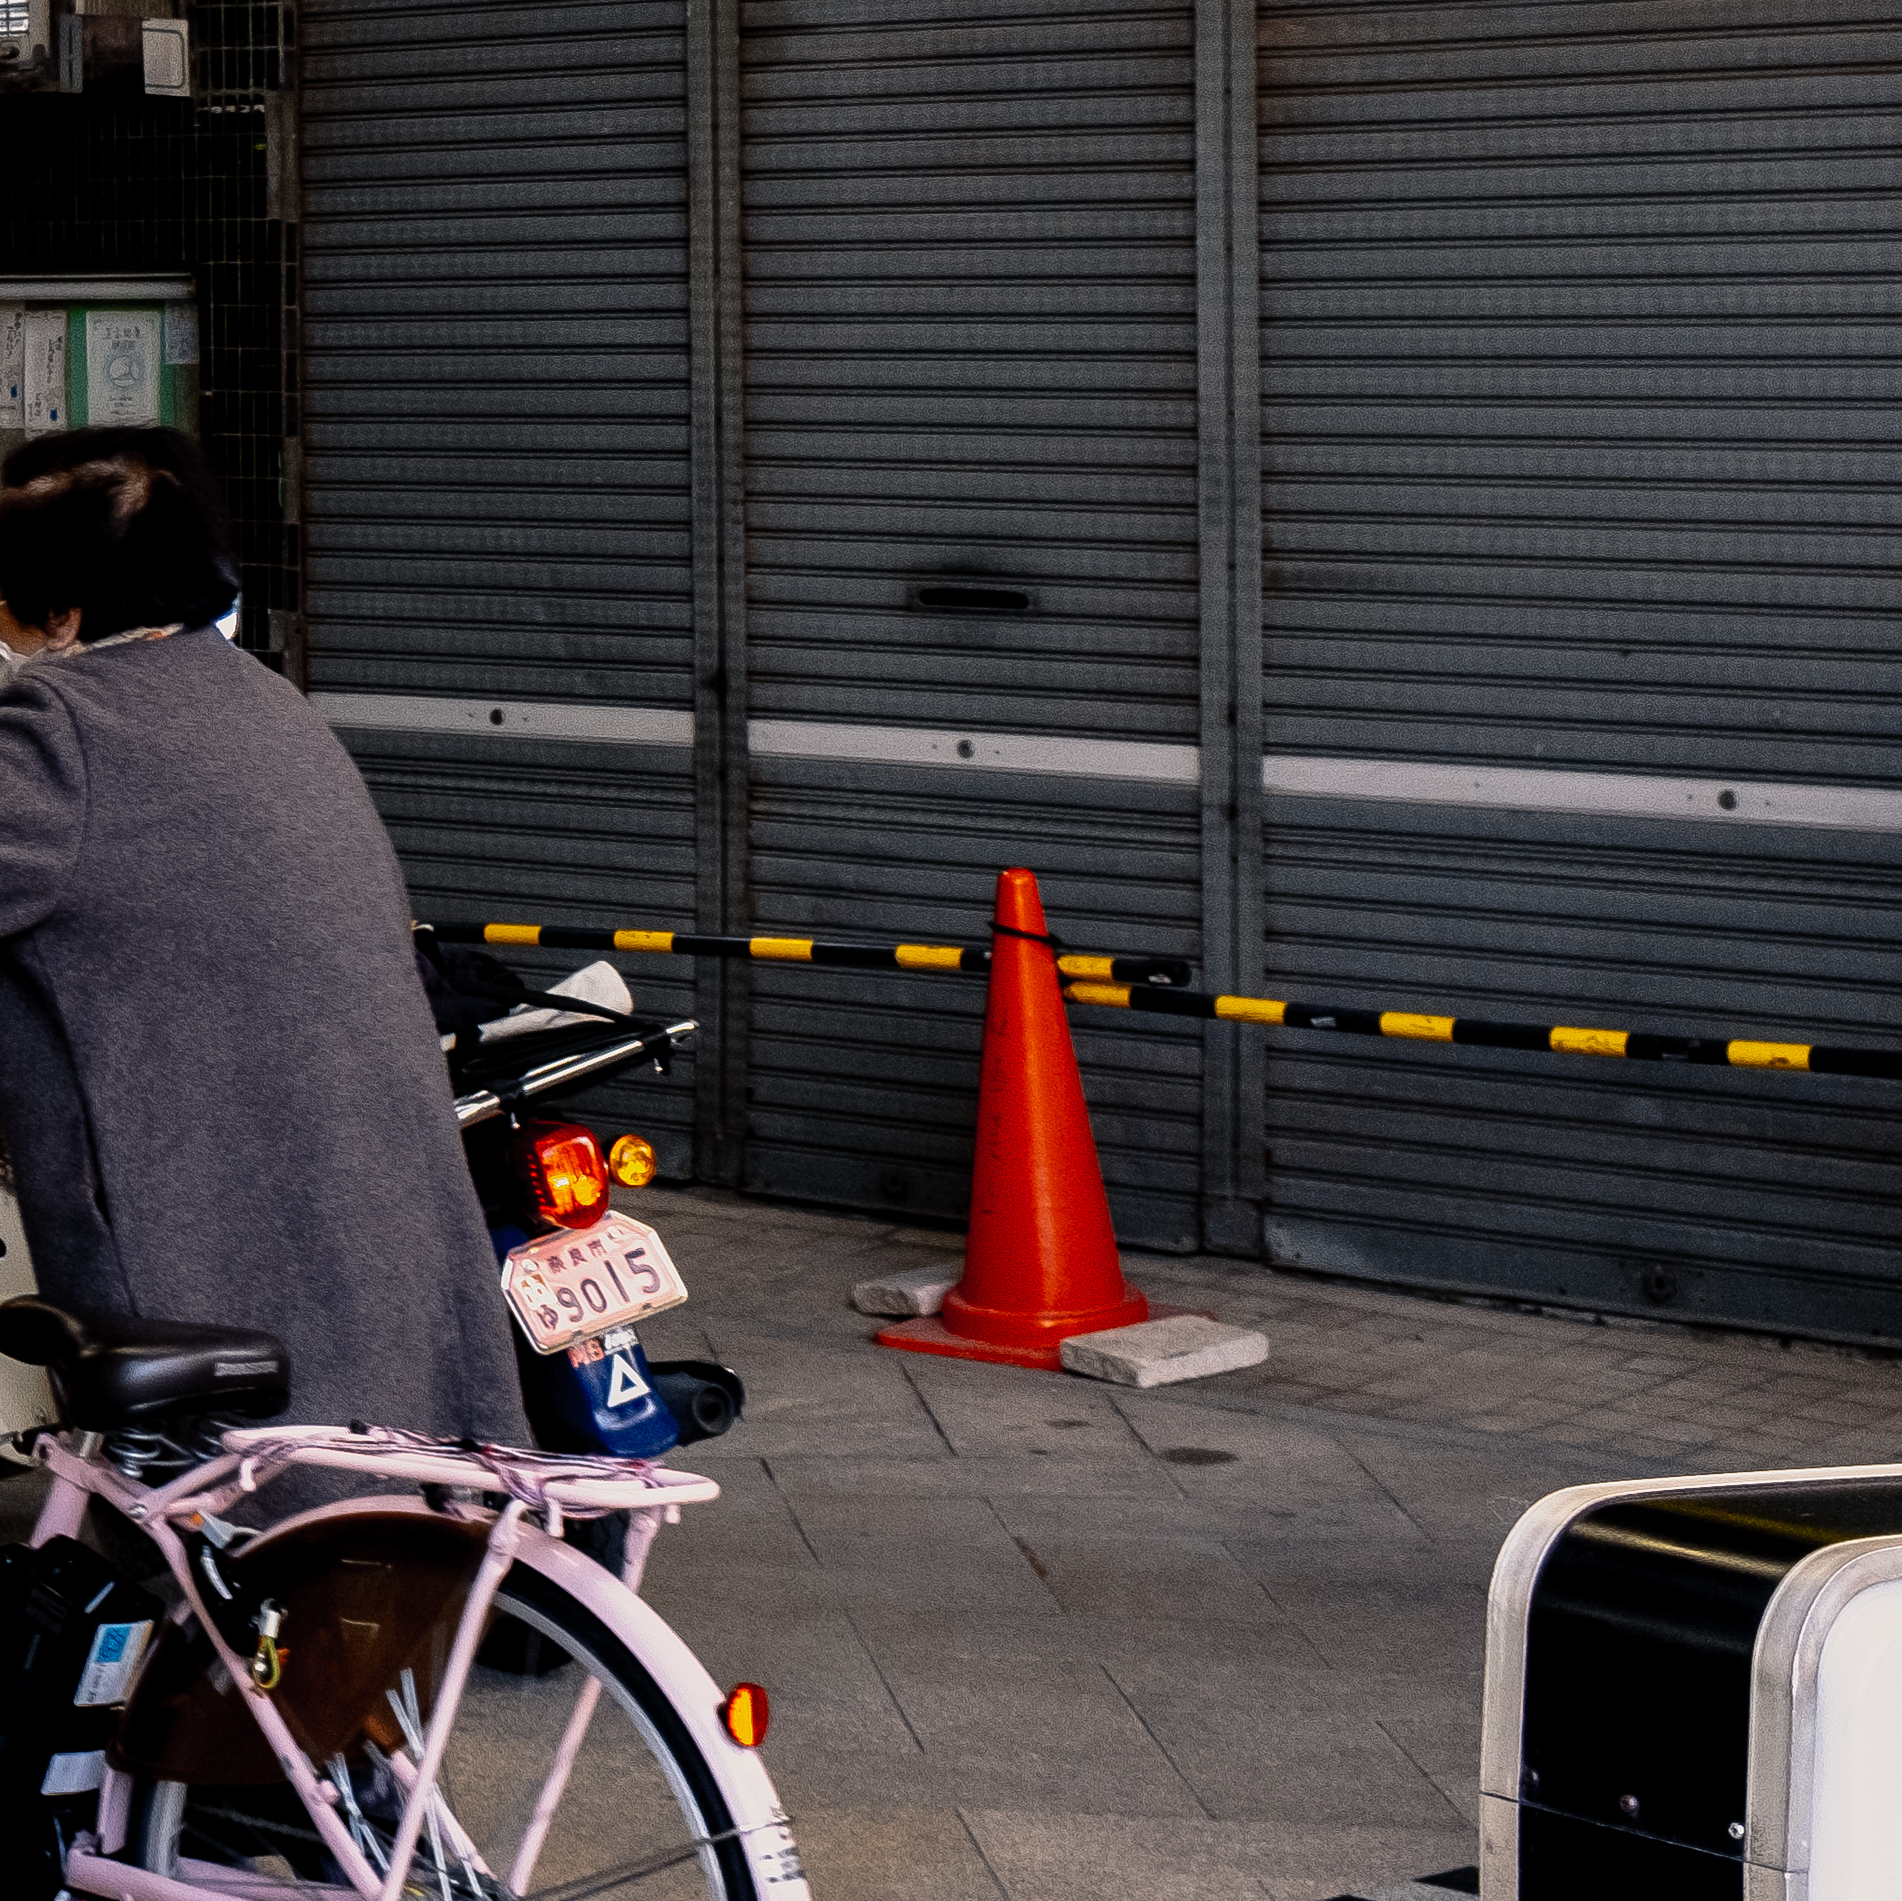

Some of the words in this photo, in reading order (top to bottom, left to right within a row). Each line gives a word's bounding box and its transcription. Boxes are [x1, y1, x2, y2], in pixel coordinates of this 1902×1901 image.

[547, 1239, 607, 1273] 奈良市
[557, 1248, 662, 1323] 9015
